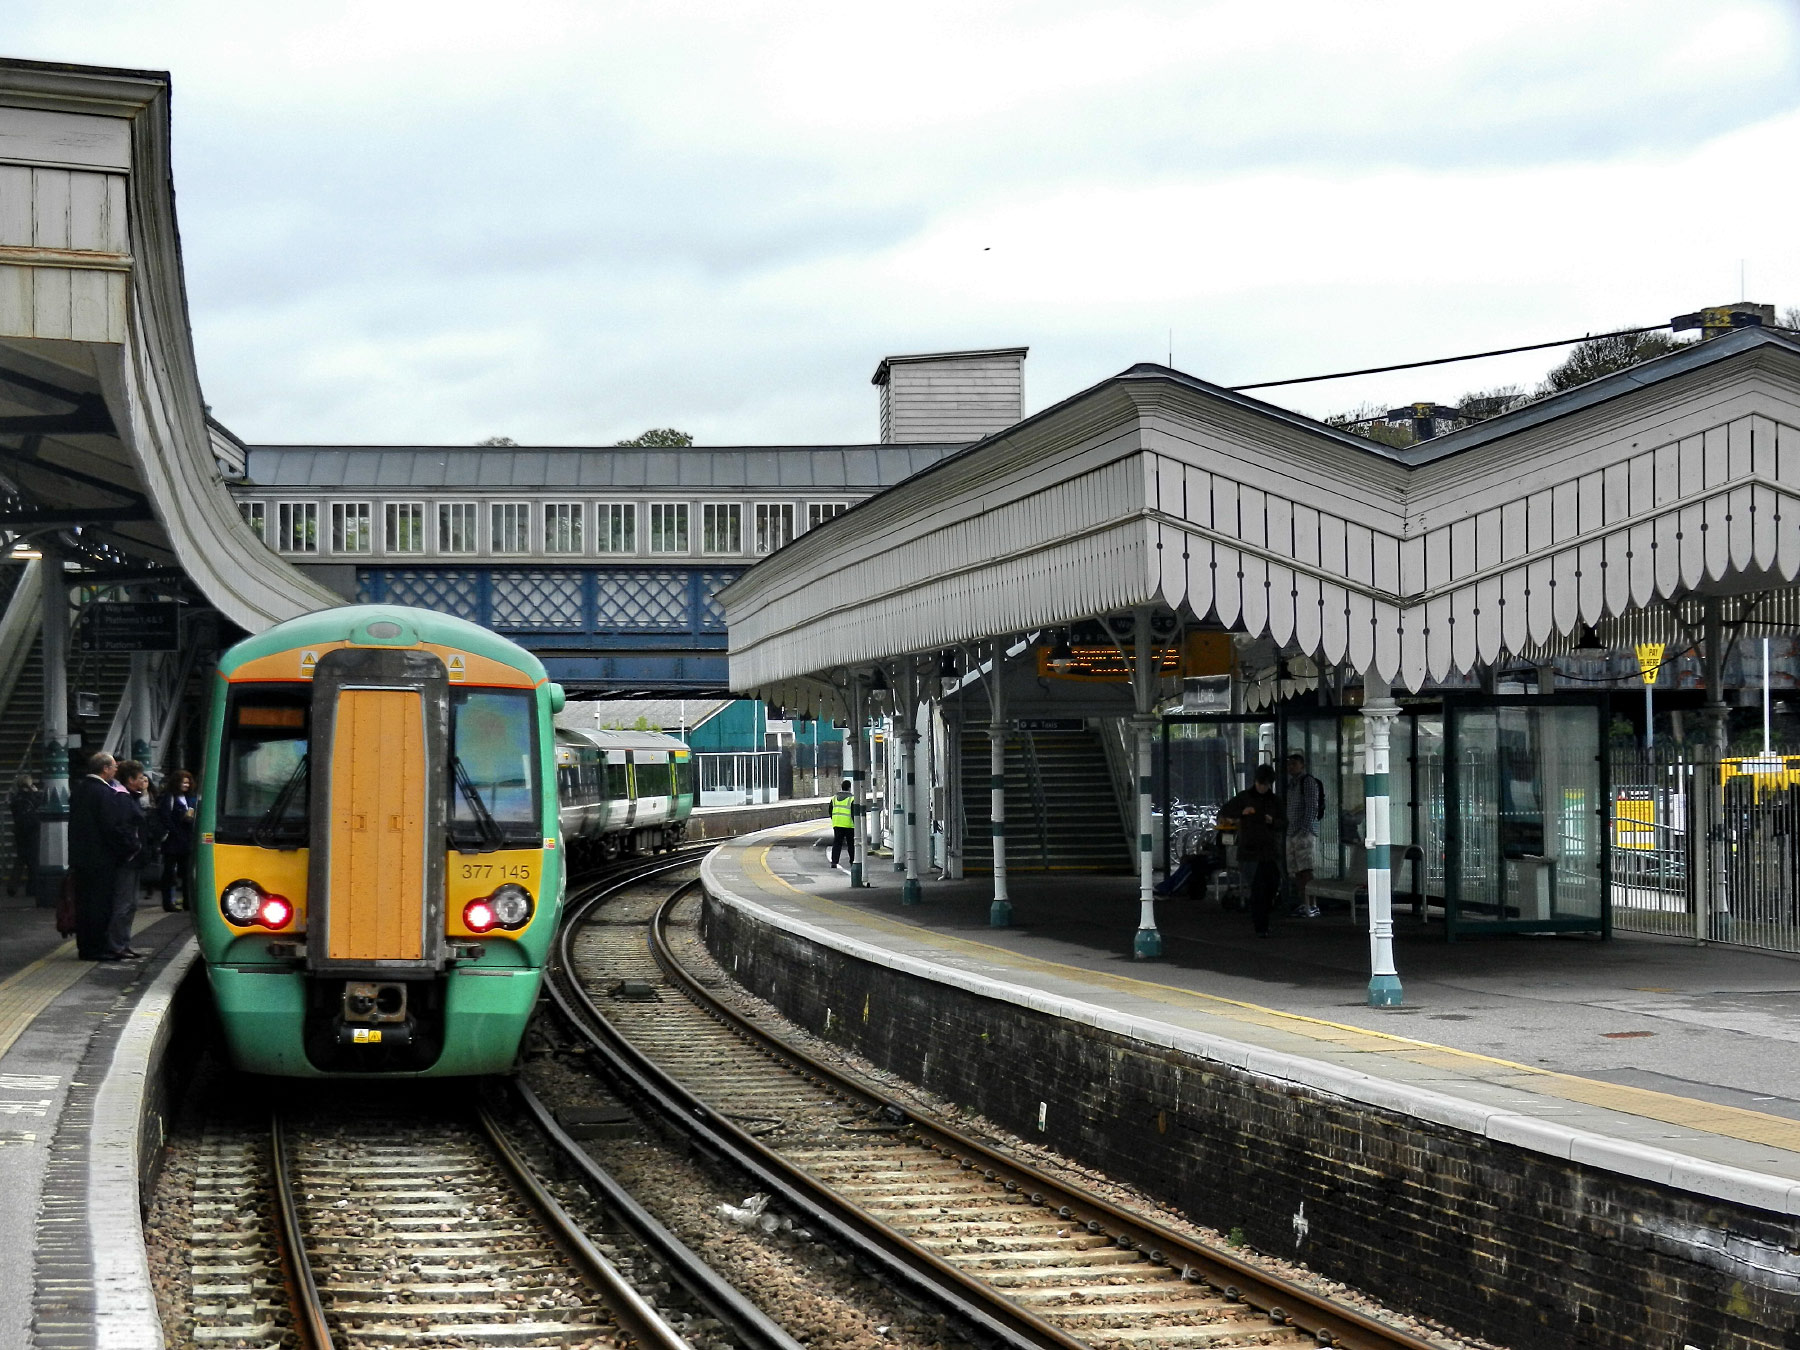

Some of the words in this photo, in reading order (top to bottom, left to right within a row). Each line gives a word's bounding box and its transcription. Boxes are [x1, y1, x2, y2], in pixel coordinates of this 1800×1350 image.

[1648, 648, 1658, 657] PAY
[1646, 658, 1659, 667] HERE
[1040, 720, 1058, 729] Taxis
[462, 864, 494, 879] 377
[500, 864, 530, 880] 145
